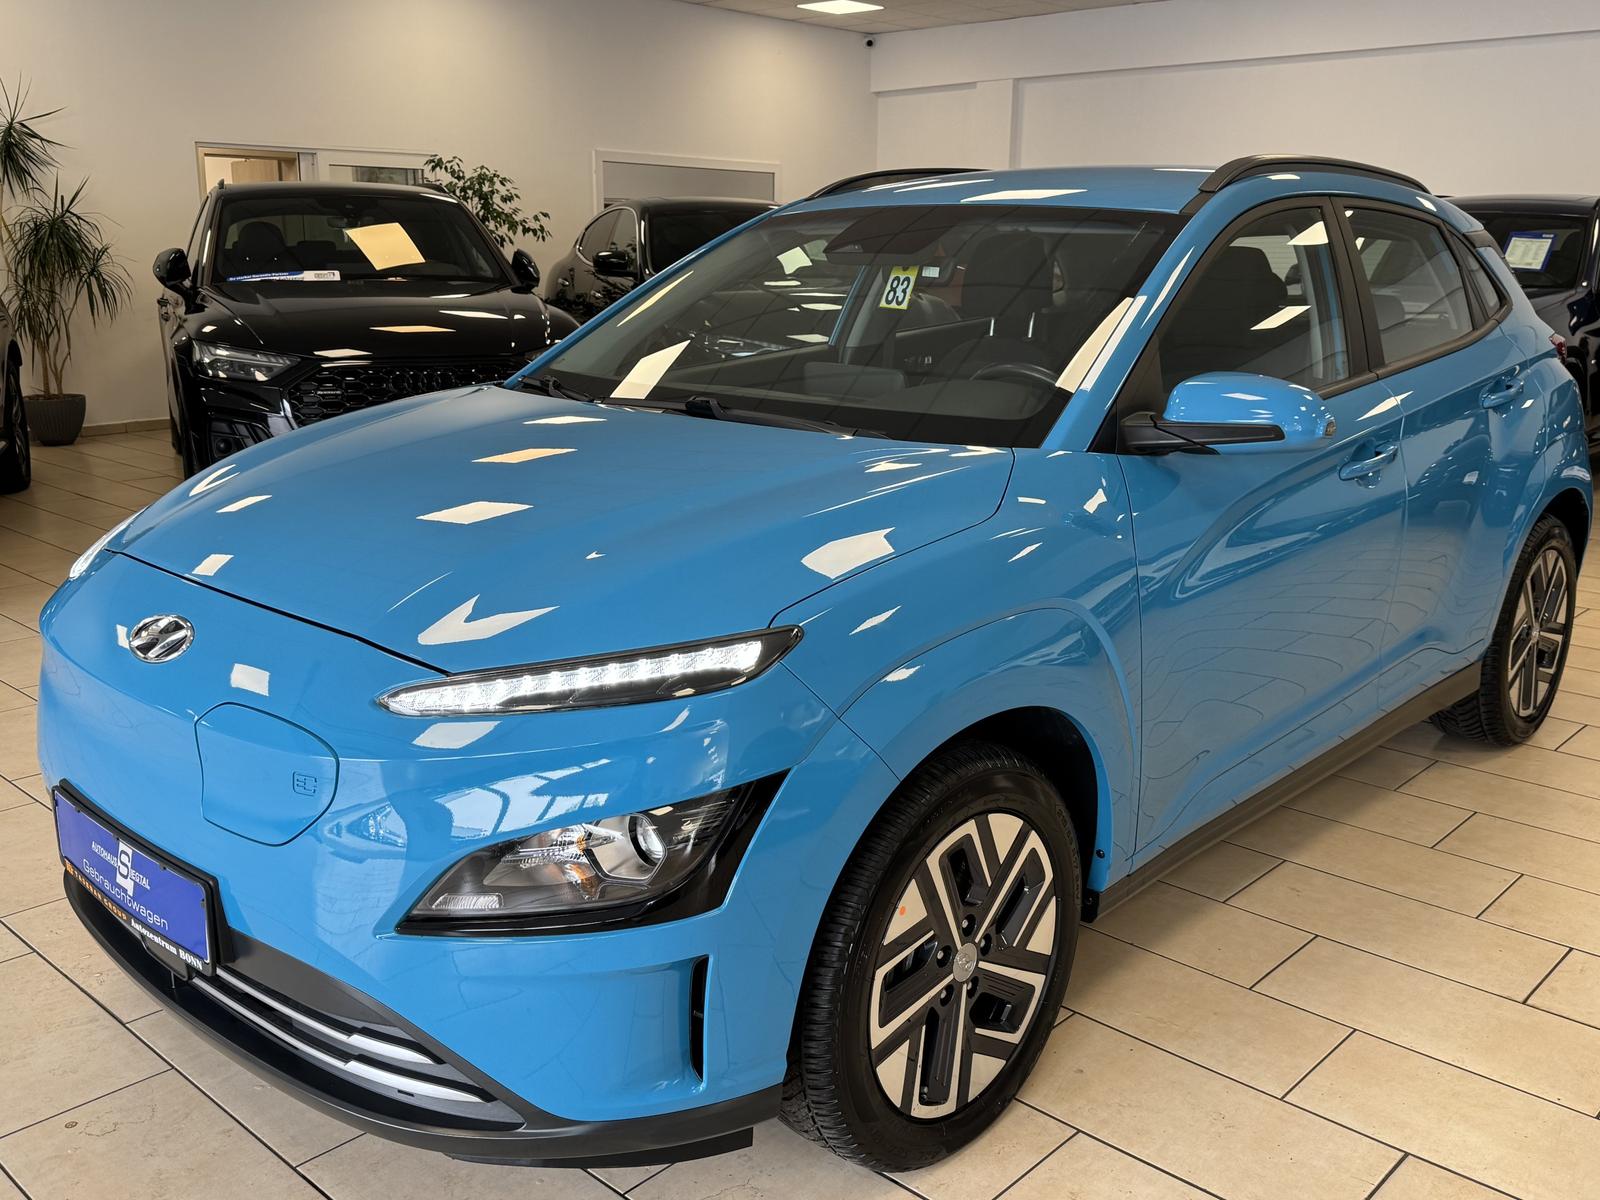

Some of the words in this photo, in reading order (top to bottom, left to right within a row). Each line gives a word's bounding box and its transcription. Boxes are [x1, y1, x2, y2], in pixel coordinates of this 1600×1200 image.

[885, 276, 910, 306] 83
[91, 841, 118, 867] AUTOHAUS
[83, 859, 168, 931] Gebrauchtwagen
[130, 918, 178, 956] Autozentrum
[179, 949, 203, 970] BONN
